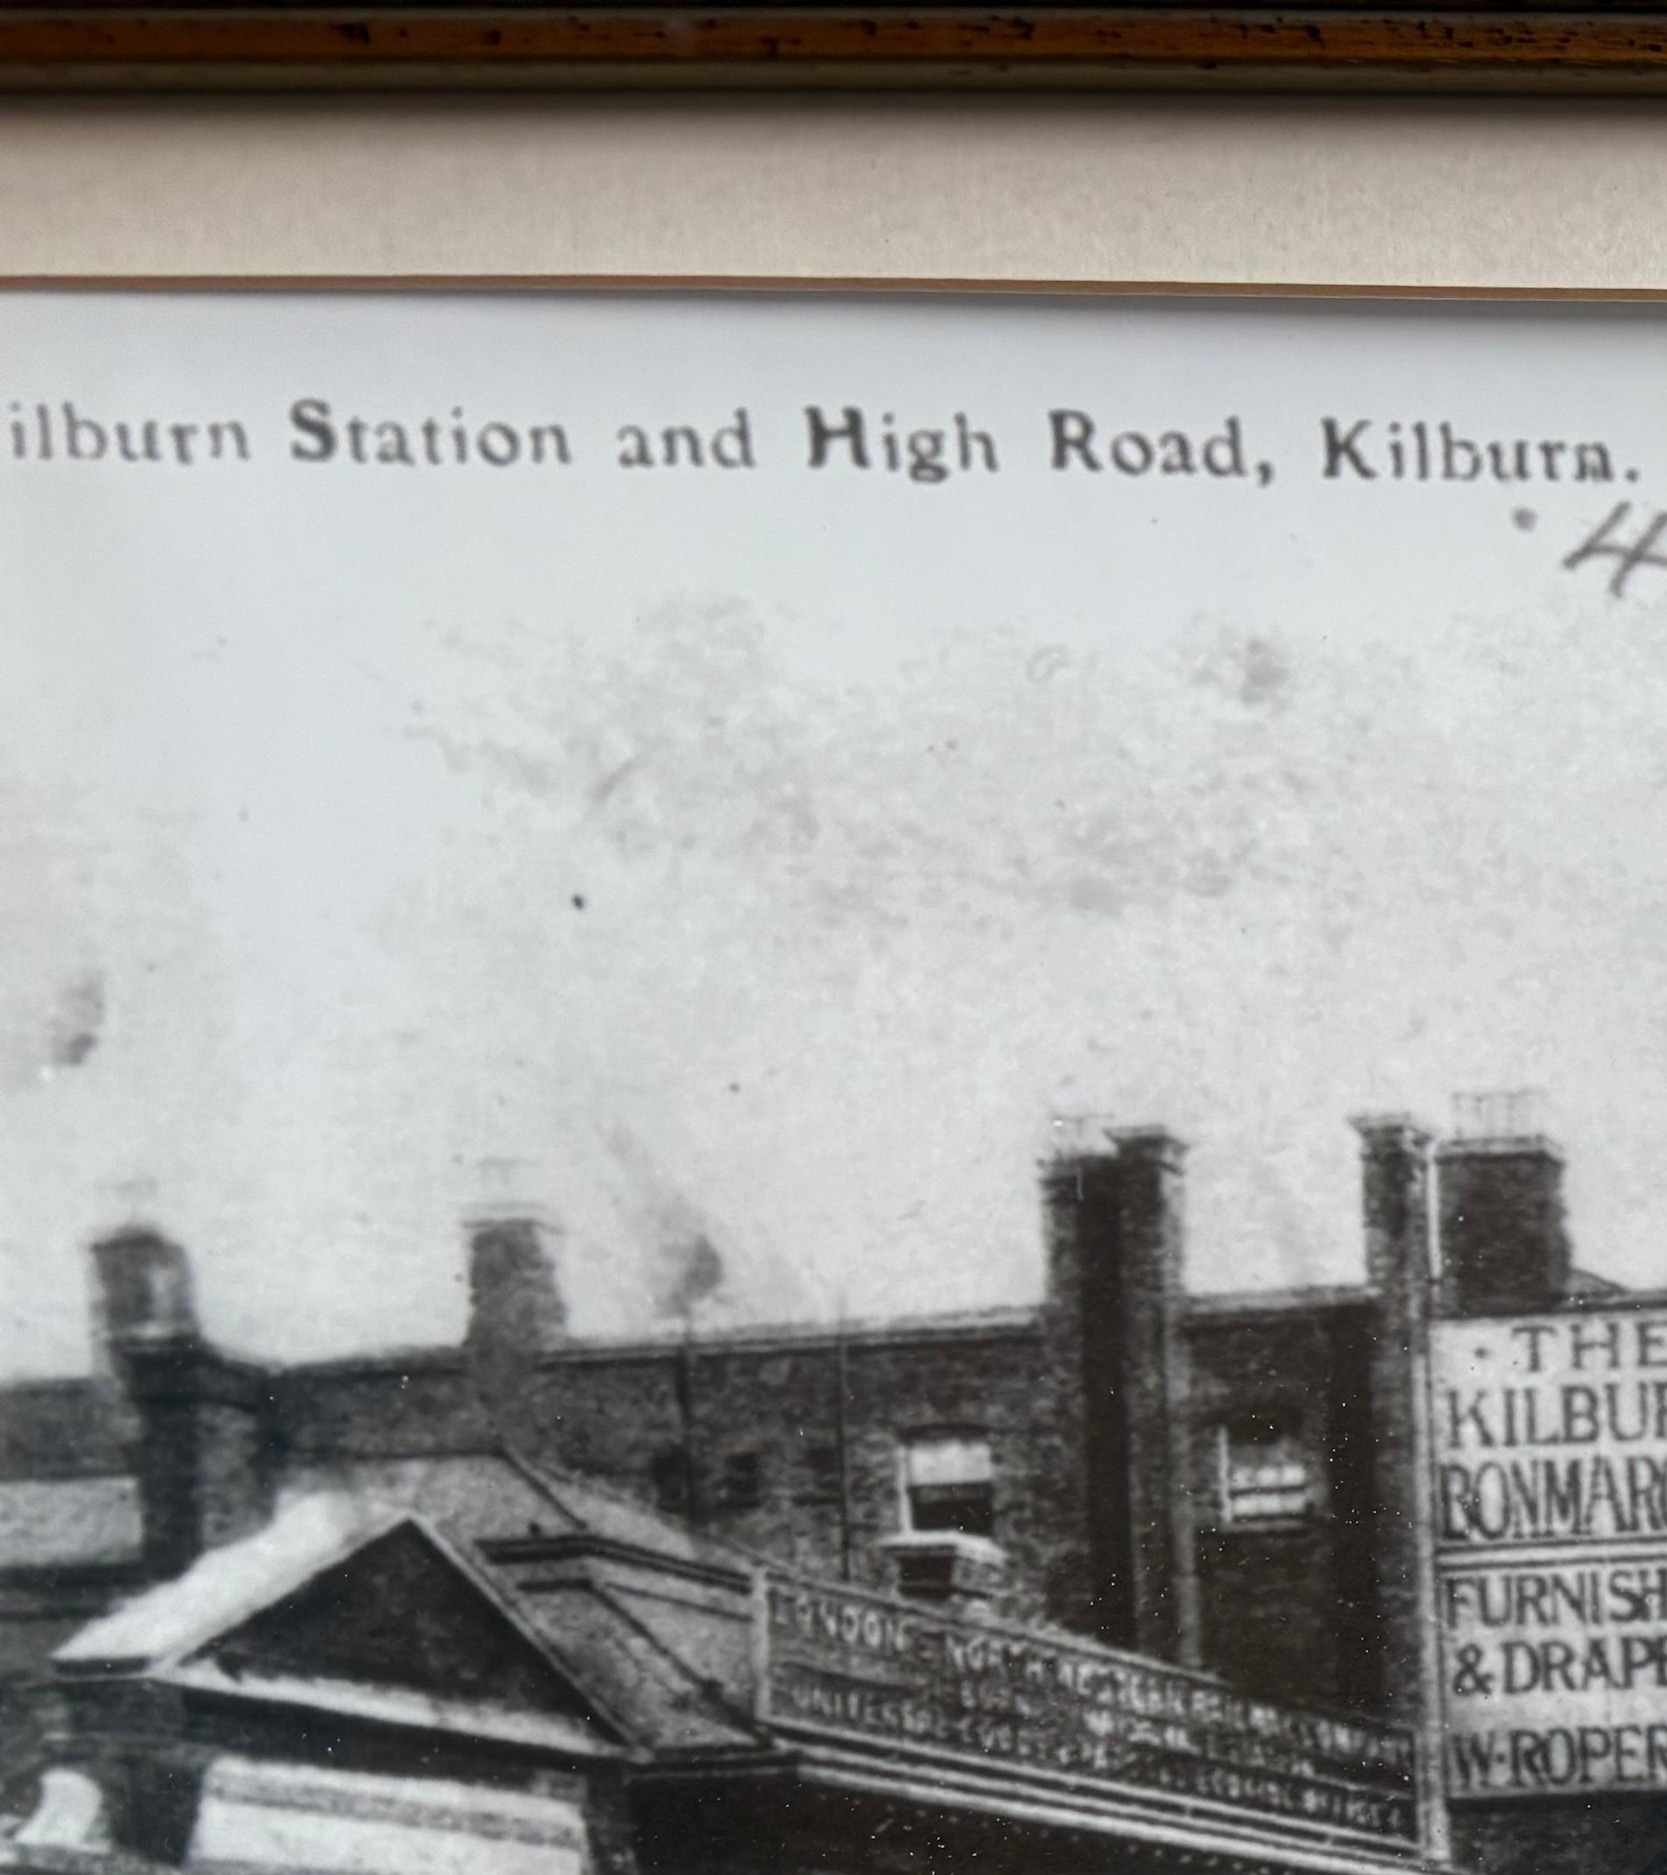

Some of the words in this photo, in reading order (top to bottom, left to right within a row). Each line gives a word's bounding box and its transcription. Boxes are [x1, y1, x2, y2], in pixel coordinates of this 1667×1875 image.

[290, 399, 573, 468] Station
[617, 408, 757, 468] and
[804, 407, 999, 483] High
[1048, 410, 1274, 487] Road,
[1322, 419, 1642, 484] Kilburn.
[1452, 1643, 1495, 1697] &
